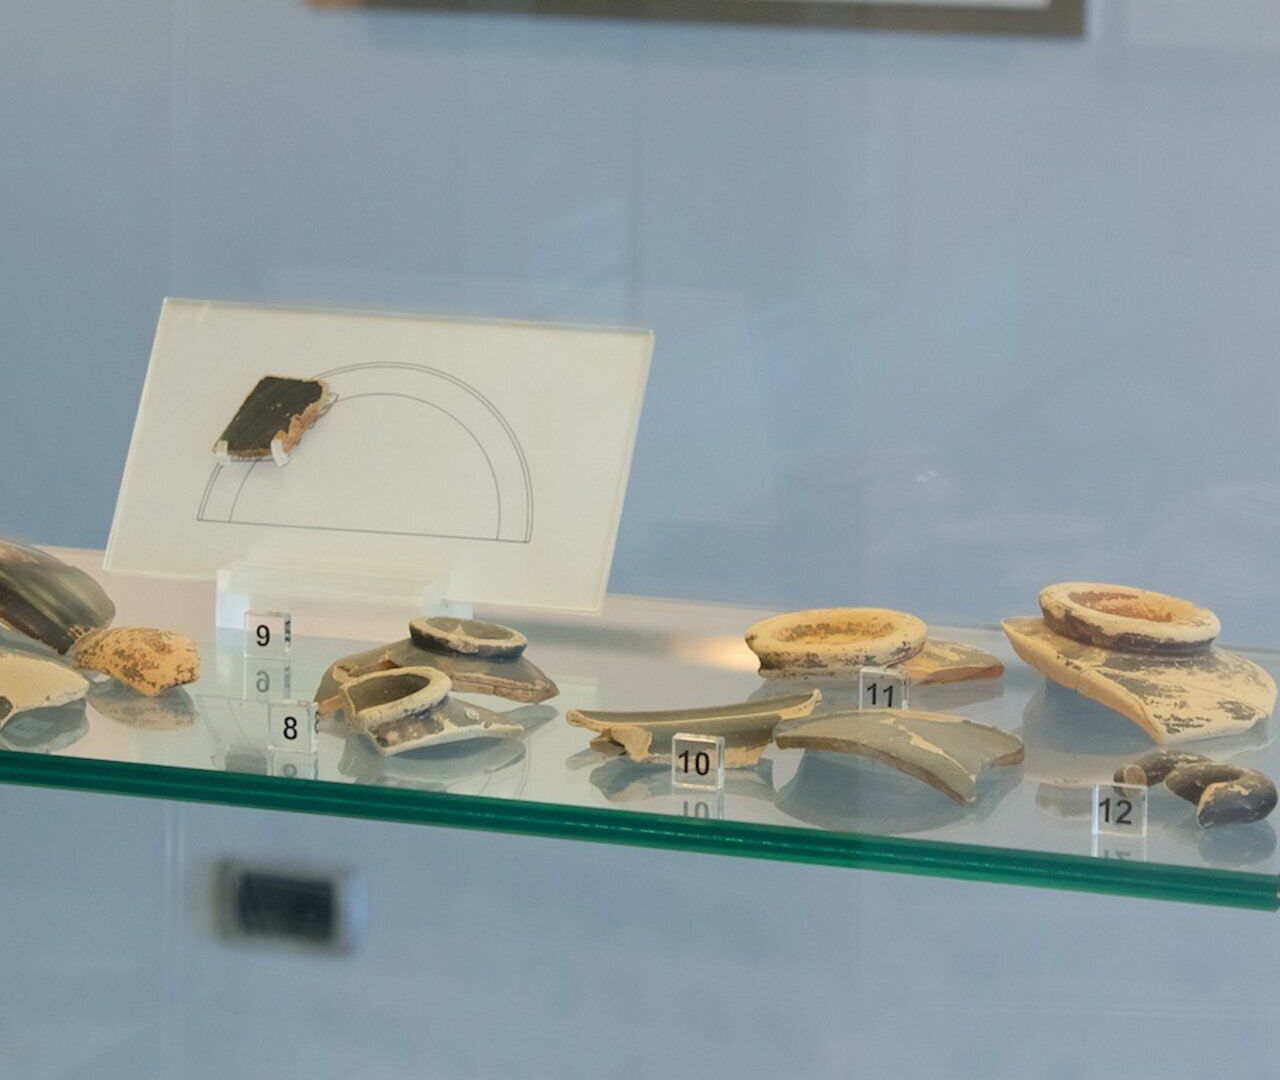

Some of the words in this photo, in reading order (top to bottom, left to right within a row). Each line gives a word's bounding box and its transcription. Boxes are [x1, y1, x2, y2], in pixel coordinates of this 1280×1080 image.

[256, 624, 270, 647] 9
[866, 682, 893, 708] 11
[283, 716, 298, 740] 8
[678, 749, 710, 776] 10
[1098, 797, 1133, 825] 12
